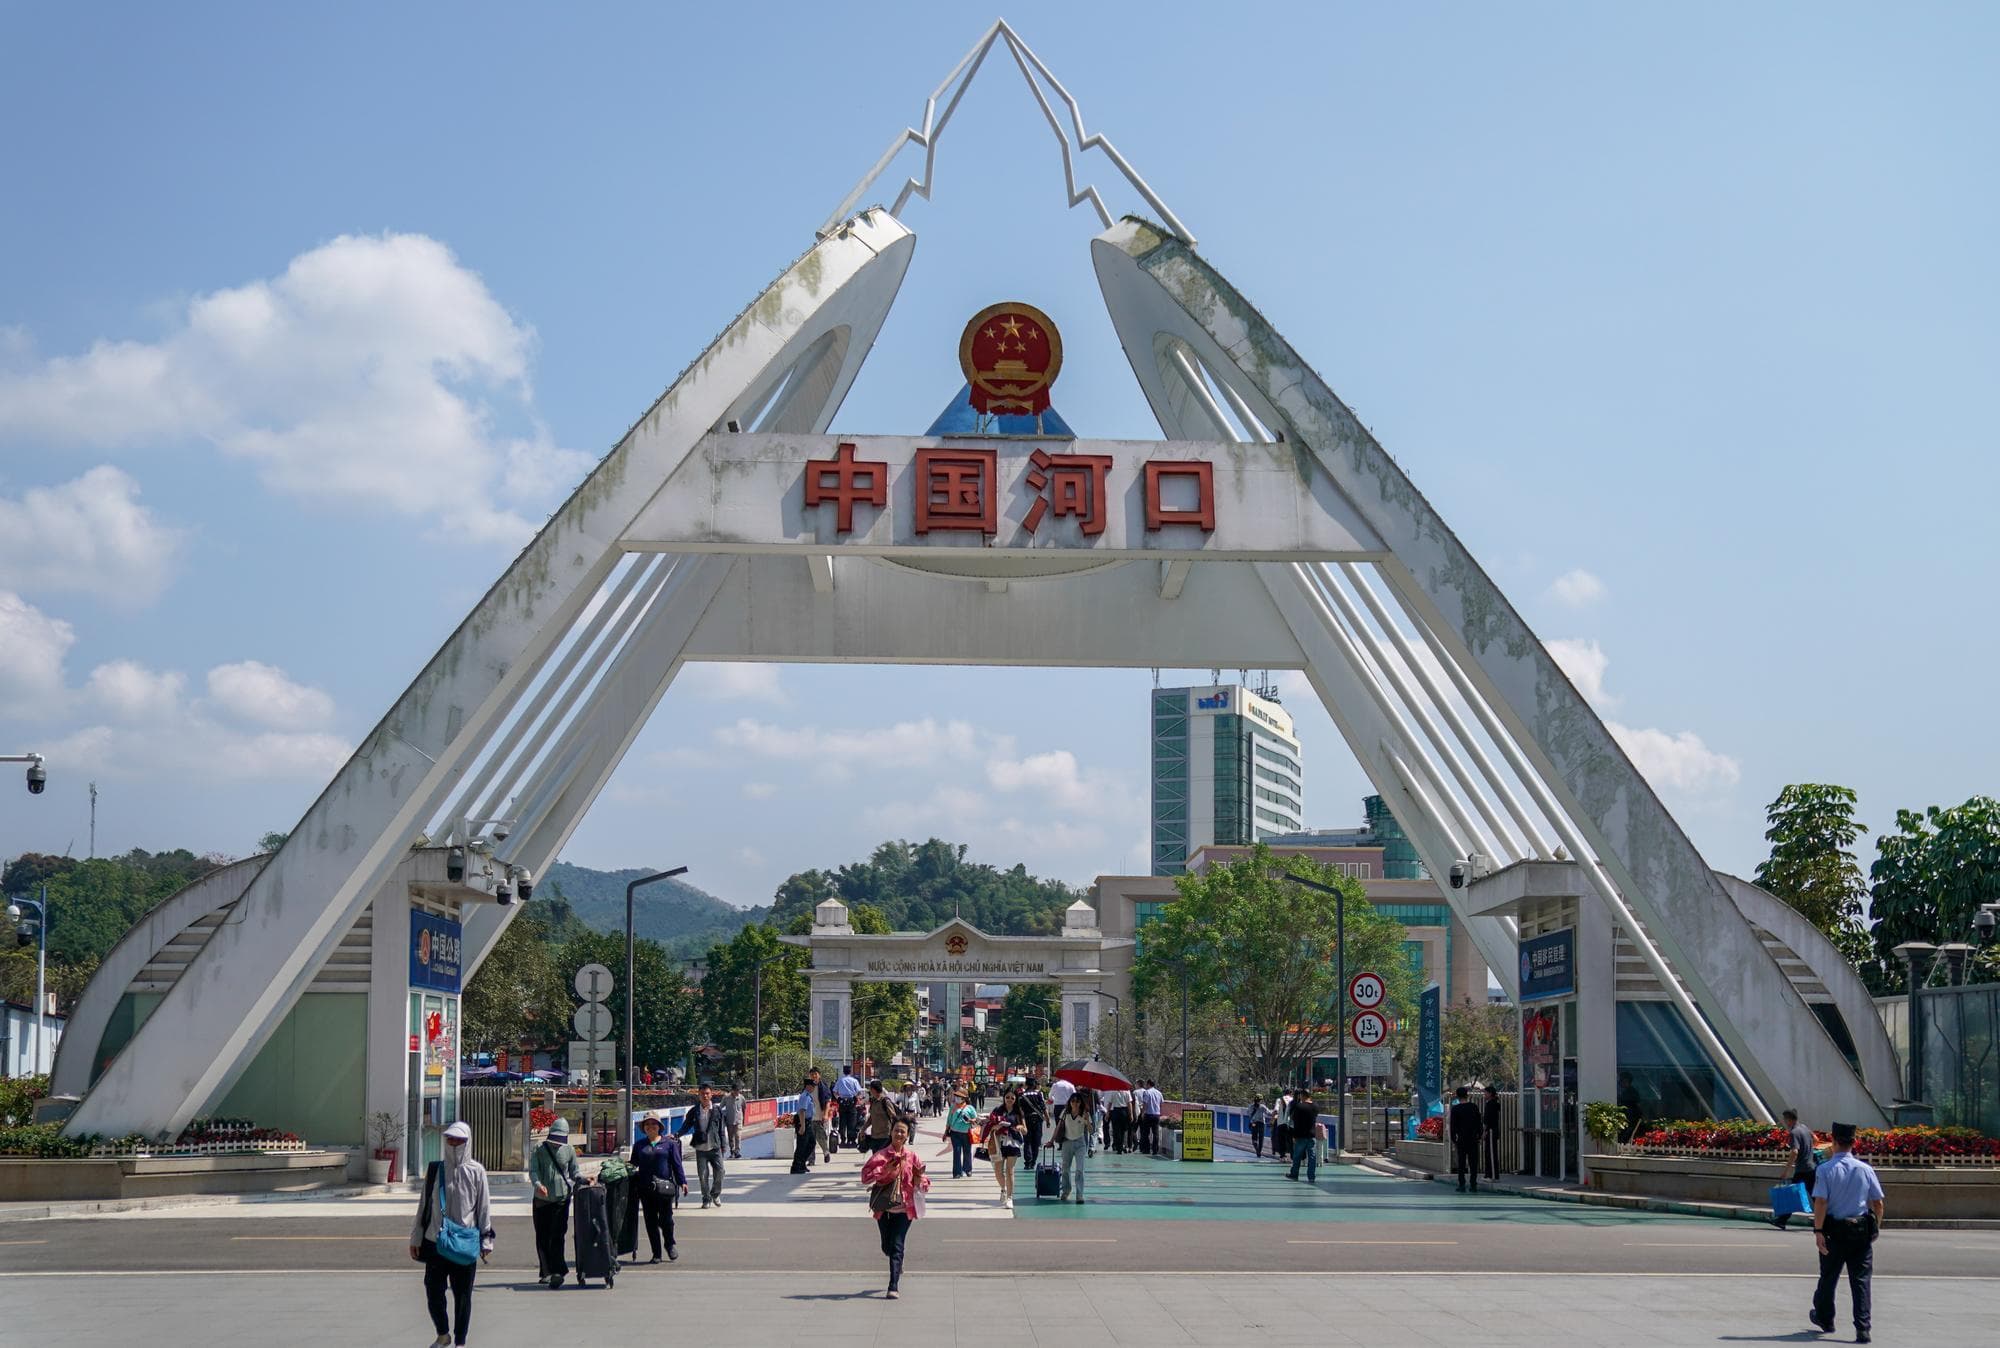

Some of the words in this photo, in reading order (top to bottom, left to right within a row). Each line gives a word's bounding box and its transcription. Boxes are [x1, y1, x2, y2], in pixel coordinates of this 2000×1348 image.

[806, 443, 1216, 536] 中国河口
[432, 930, 460, 965] 中国公路
[964, 960, 980, 972] CHỦ
[1026, 963, 1044, 972] NAM
